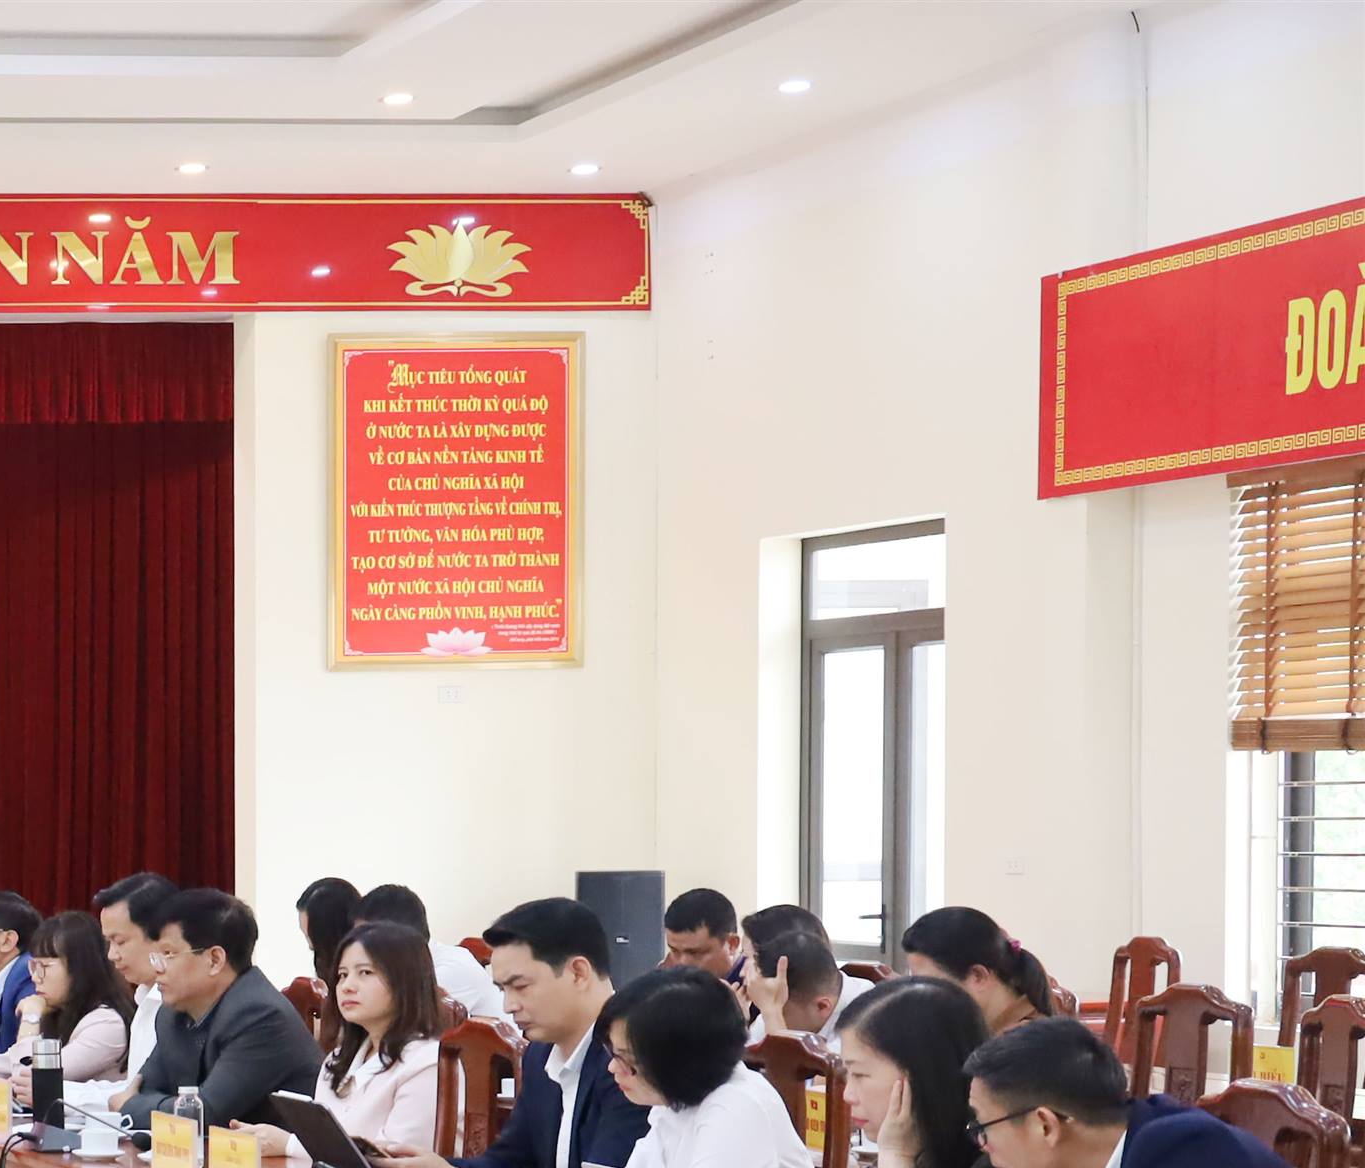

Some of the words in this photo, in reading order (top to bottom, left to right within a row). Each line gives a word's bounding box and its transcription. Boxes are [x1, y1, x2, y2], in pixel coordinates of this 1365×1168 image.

[52, 215, 241, 286] NĂM
[428, 368, 456, 384] TIÊU
[494, 367, 526, 386] QUÁT
[364, 400, 386, 412] KHI
[415, 396, 448, 412] THÚC
[451, 395, 481, 411] THỜI
[485, 395, 500, 411] KỲ
[502, 395, 527, 414] QUÁ
[530, 395, 548, 414] ĐỘ
[366, 422, 376, 439] Ở
[379, 422, 413, 438] NƯỚC
[416, 425, 431, 438] TA
[434, 422, 448, 438] LÀ
[450, 422, 471, 438] XÂY
[475, 424, 509, 441] DỰNG
[512, 423, 546, 440] ĐƯỢC
[387, 450, 405, 464] CƠ
[407, 448, 430, 464] BẢN
[461, 447, 493, 463] TẢNG
[496, 451, 526, 463] KINH
[388, 474, 412, 490] CỦA
[415, 474, 440, 490] CHỦ
[444, 474, 481, 490] NGHĨA
[484, 474, 498, 489] XÃ
[501, 473, 524, 493] HỘI
[368, 529, 385, 543] TƯ
[387, 526, 433, 544] TƯỞNG,
[436, 527, 458, 542] VĂN
[462, 526, 487, 541] HÓA
[490, 526, 514, 541] PHÙ
[351, 556, 376, 572] TẠO
[378, 555, 396, 569] CƠ
[398, 552, 415, 568] SỞ
[438, 551, 471, 568] NƯỚC
[474, 555, 489, 567] TA
[491, 551, 516, 567] TRỞ
[518, 551, 559, 566] THÀNH
[368, 579, 395, 598] MỘT
[398, 578, 432, 594] NƯỚC
[435, 578, 450, 594] XÃ
[453, 578, 475, 597] HỘI
[478, 577, 503, 593] CHỦ
[507, 577, 544, 592] NGHĨA
[352, 604, 384, 621] NGÀY
[385, 604, 416, 620] CÀNG
[489, 606, 522, 622] HẠNH
